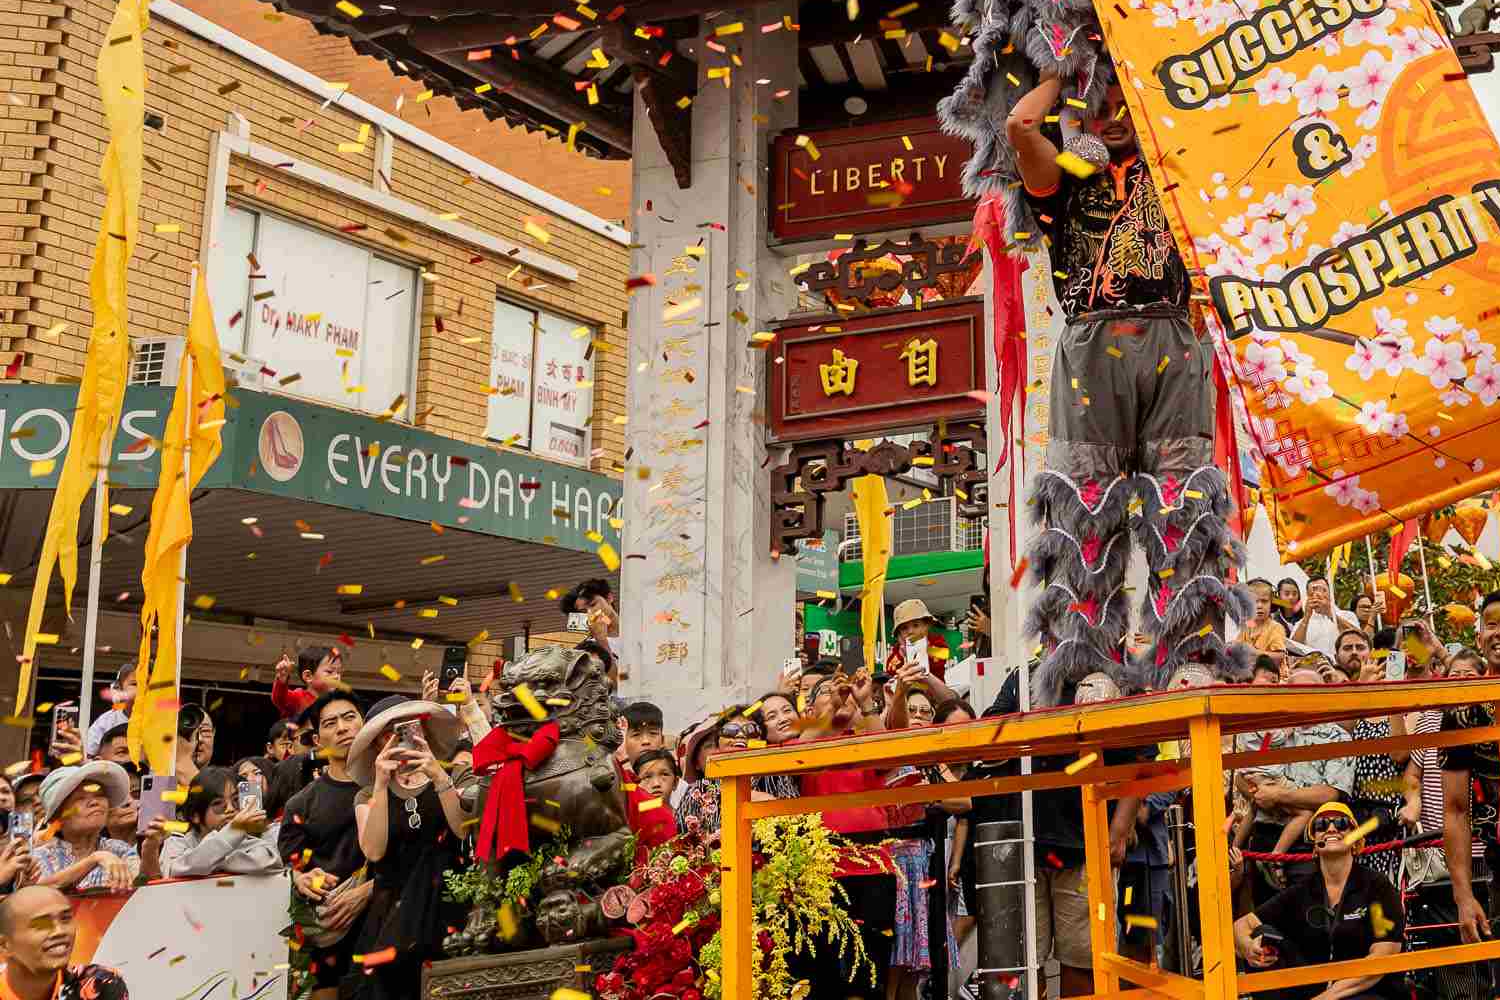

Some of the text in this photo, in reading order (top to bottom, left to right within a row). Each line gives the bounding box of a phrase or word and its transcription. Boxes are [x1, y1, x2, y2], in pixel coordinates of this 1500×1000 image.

[810, 154, 949, 196] LIBERTY
[1293, 123, 1352, 180] &
[286, 310, 320, 338] MARY
[326, 322, 359, 352] PHAM
[327, 433, 452, 503] EVERY
[469, 461, 537, 521] DAY
